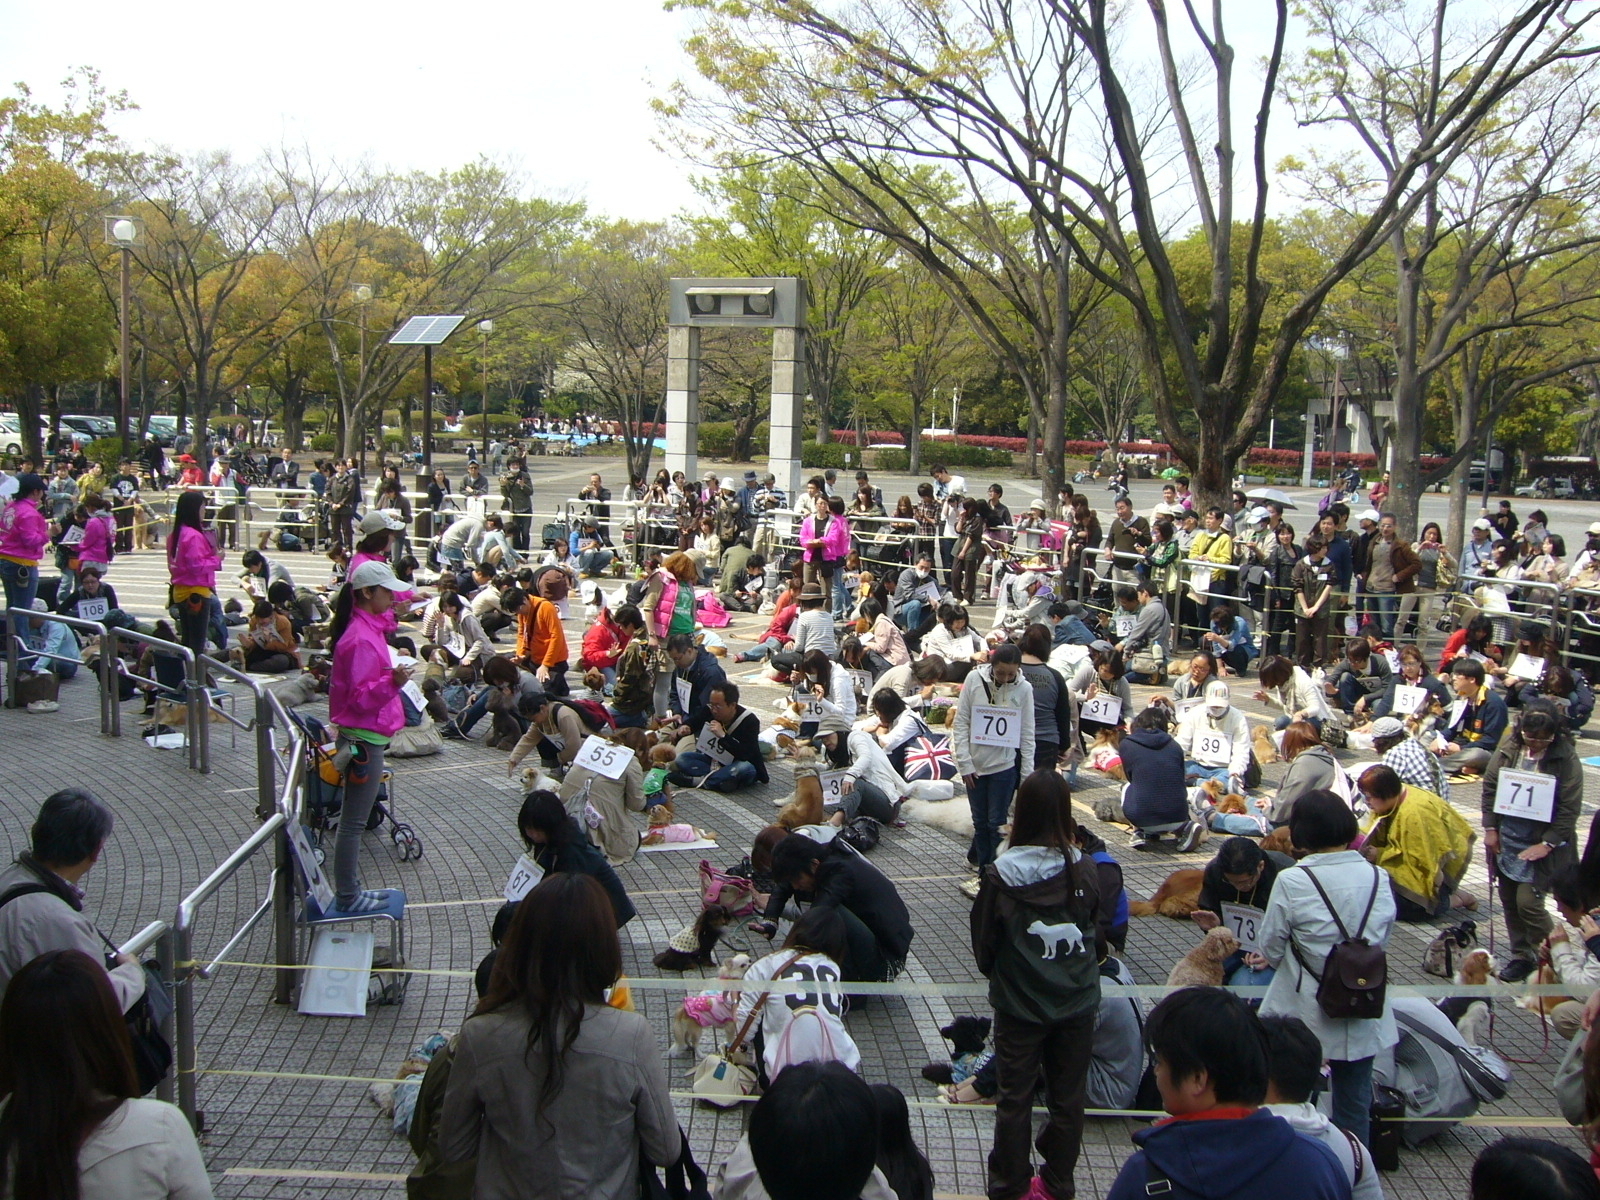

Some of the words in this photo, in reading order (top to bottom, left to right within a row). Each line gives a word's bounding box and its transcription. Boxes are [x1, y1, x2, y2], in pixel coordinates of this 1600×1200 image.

[83, 604, 105, 616] 108
[1121, 621, 1134, 632] 23
[851, 676, 866, 689] 18
[1090, 700, 1109, 716] 31
[1402, 694, 1416, 707] 51
[983, 716, 1008, 736] 70
[707, 737, 726, 755] 49
[1201, 738, 1220, 753] 39
[590, 746, 616, 766] 55
[830, 778, 844, 796] 3
[1511, 783, 1534, 807] 71
[512, 869, 530, 894] 67
[1233, 916, 1256, 942] 73
